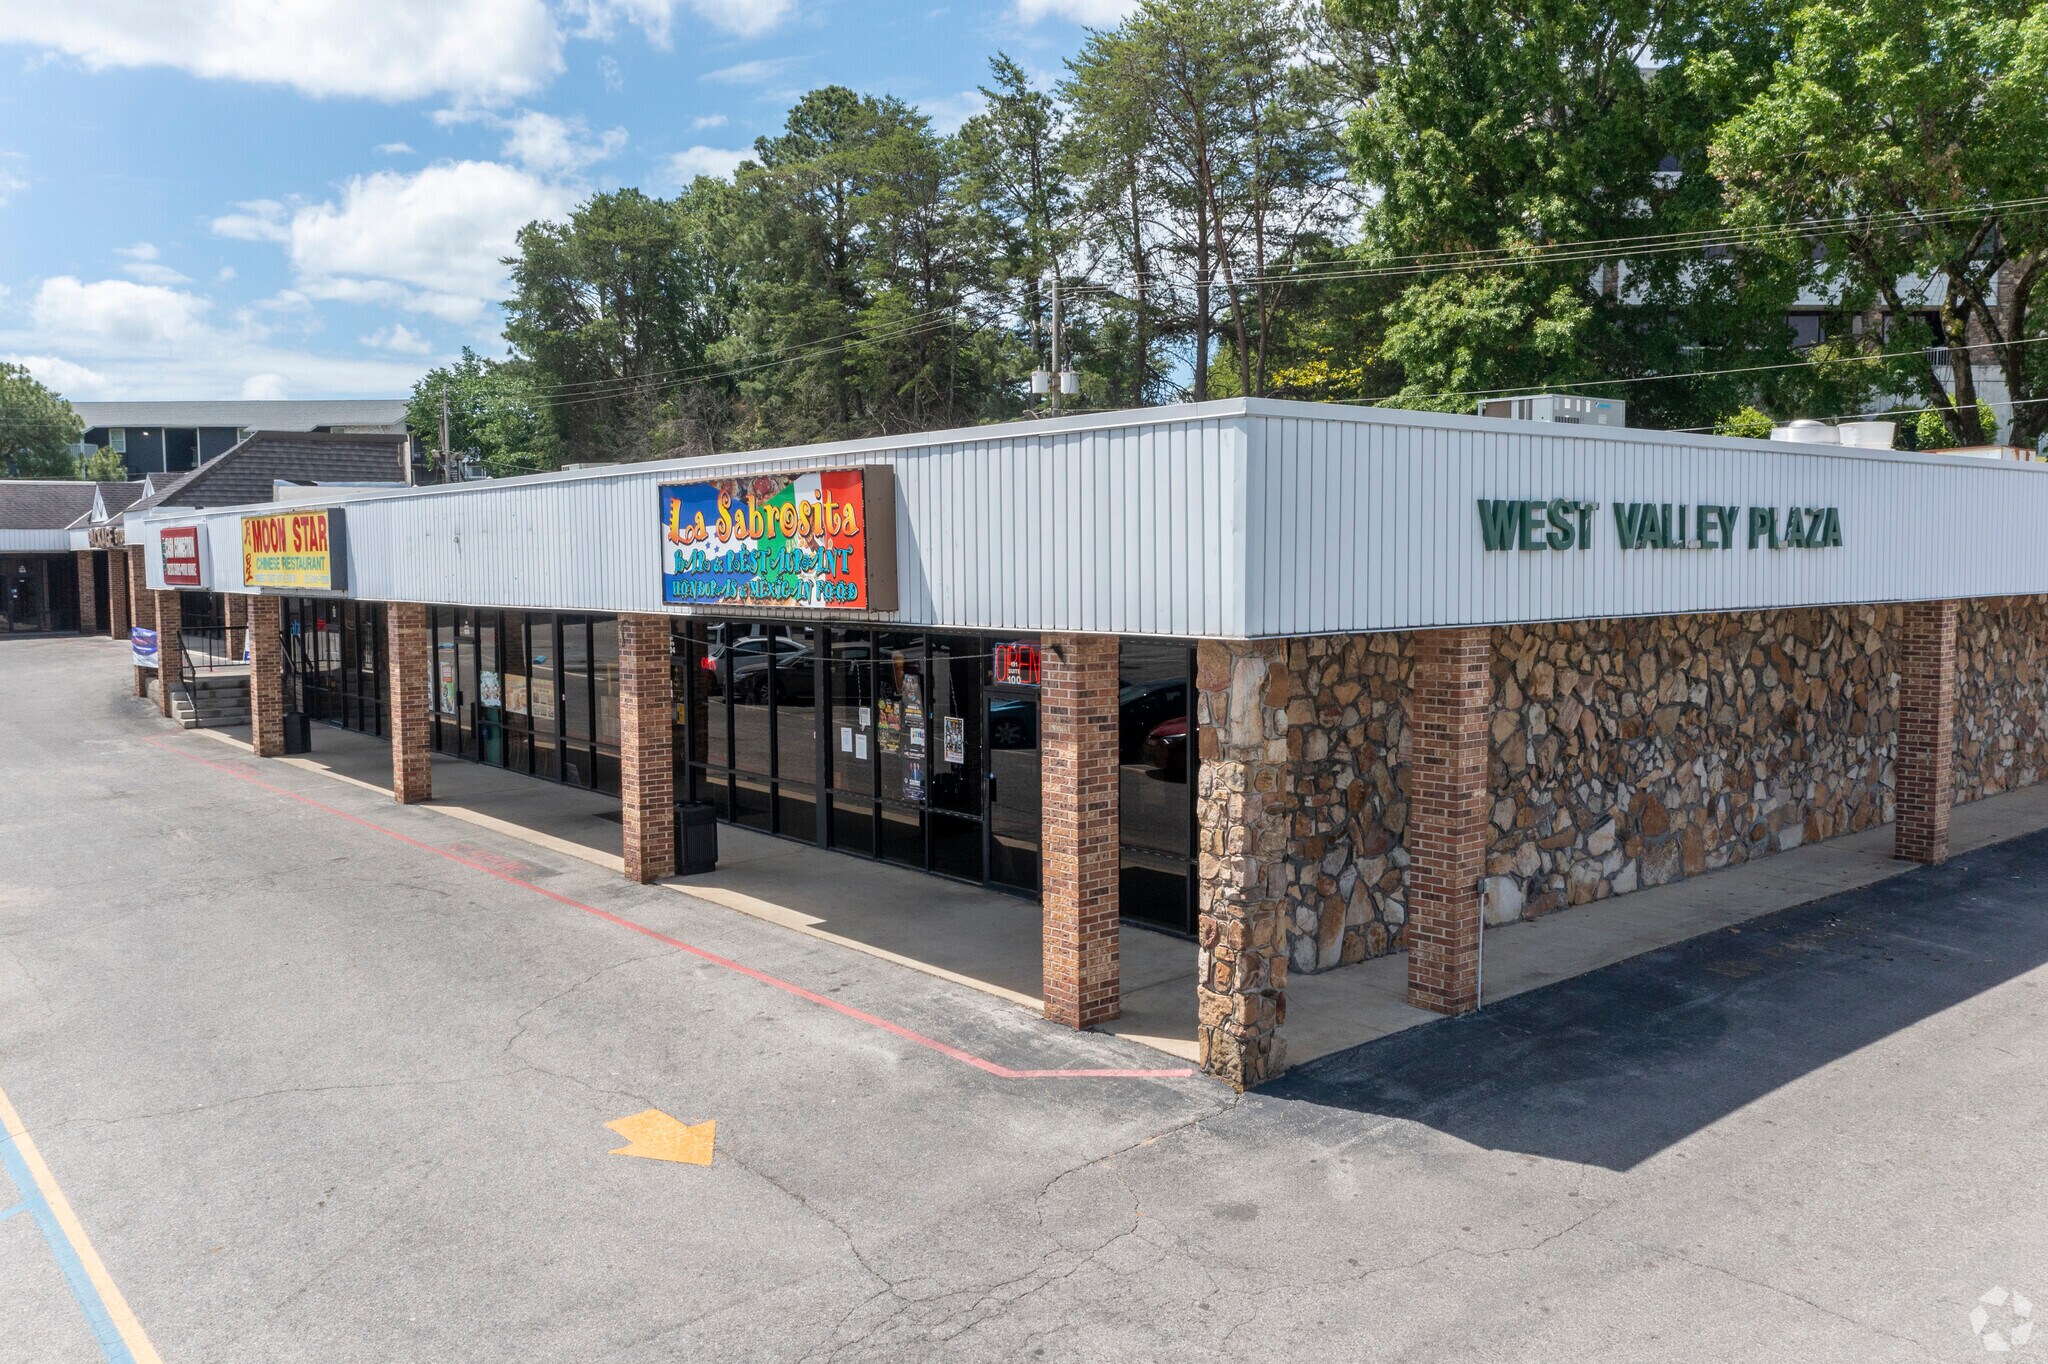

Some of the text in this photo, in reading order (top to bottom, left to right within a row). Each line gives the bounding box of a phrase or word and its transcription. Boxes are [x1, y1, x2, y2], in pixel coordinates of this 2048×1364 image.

[251, 515, 328, 553] MOON STAR
[668, 488, 860, 546] La Sabrosita
[1477, 497, 1843, 551] WEST VALLEY PLAZA
[256, 556, 325, 570] CHINESE RESTAURANT
[674, 548, 711, 576] BAR
[725, 542, 854, 579] RESTAURANT
[672, 578, 739, 601] HONDURAS
[749, 574, 813, 604] MEXICAN
[816, 579, 859, 604] FOOD
[702, 656, 717, 671] OPEN
[996, 645, 1041, 684] OPEN
[1007, 675, 1021, 685] 100
